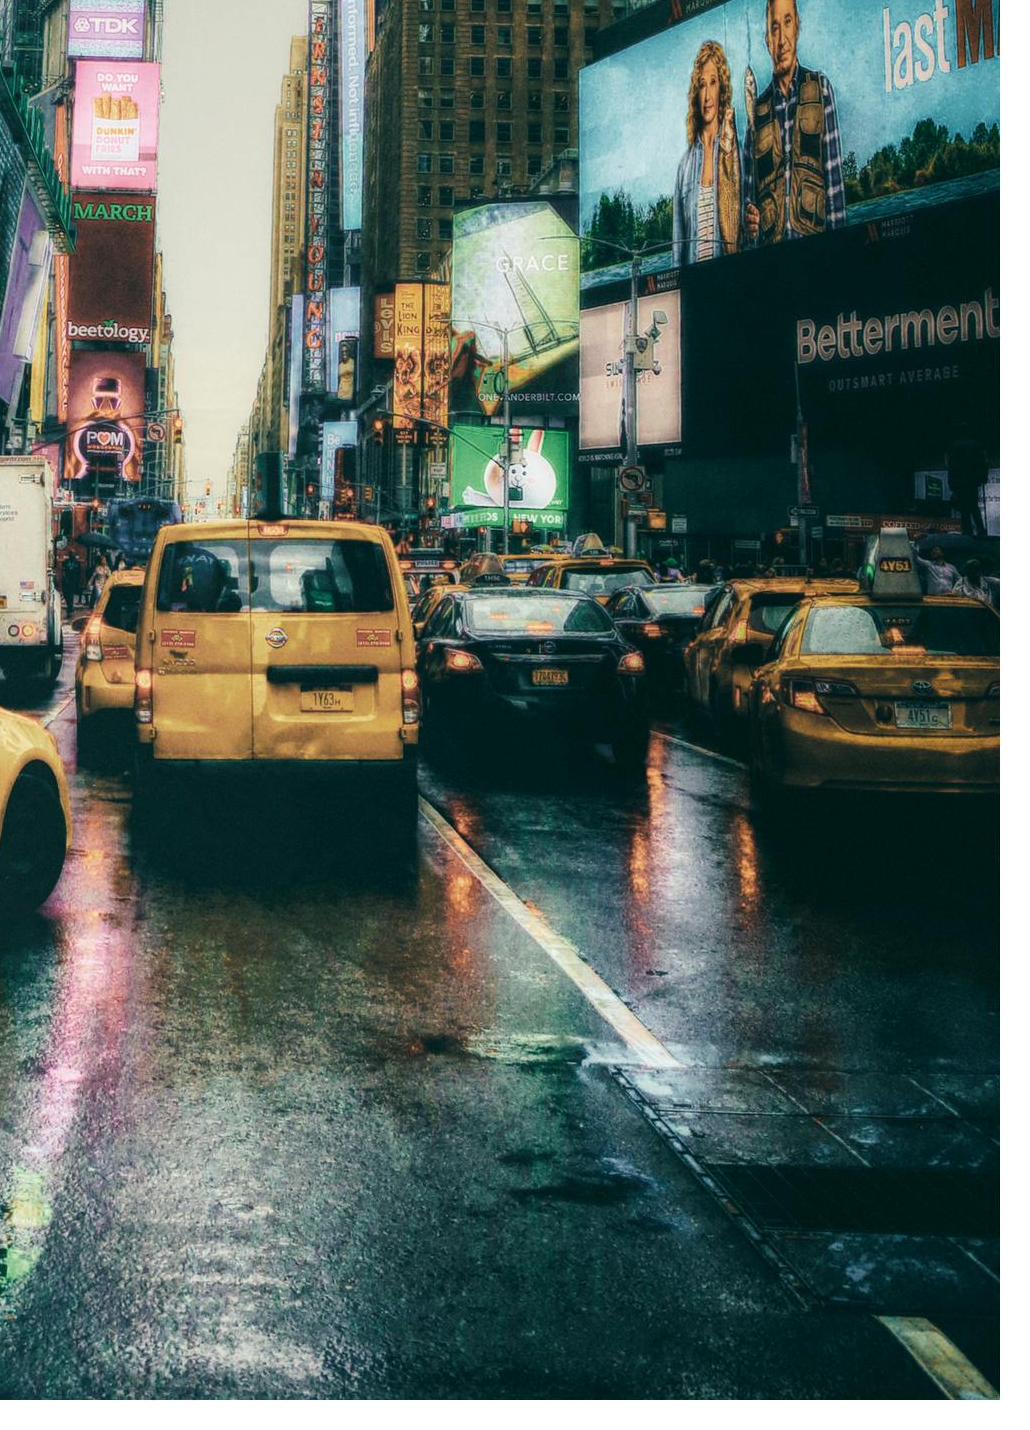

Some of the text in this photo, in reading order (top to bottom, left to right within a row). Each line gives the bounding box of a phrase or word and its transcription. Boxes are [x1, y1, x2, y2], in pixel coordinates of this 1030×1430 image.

[90, 18, 139, 34] TDK
[97, 73, 139, 83] DO YOU
[102, 83, 133, 92] WANT
[82, 166, 147, 176] WITH THAT?
[74, 202, 153, 222] MARCH
[497, 255, 569, 272] GRACE
[398, 312, 418, 322] LION
[68, 320, 148, 343] beetology
[397, 325, 420, 338] KING
[797, 287, 1000, 364] Betterment
[828, 366, 960, 392] OUTSMART AVERAGE
[540, 514, 564, 524] YOR
[880, 561, 911, 571] 4Y51
